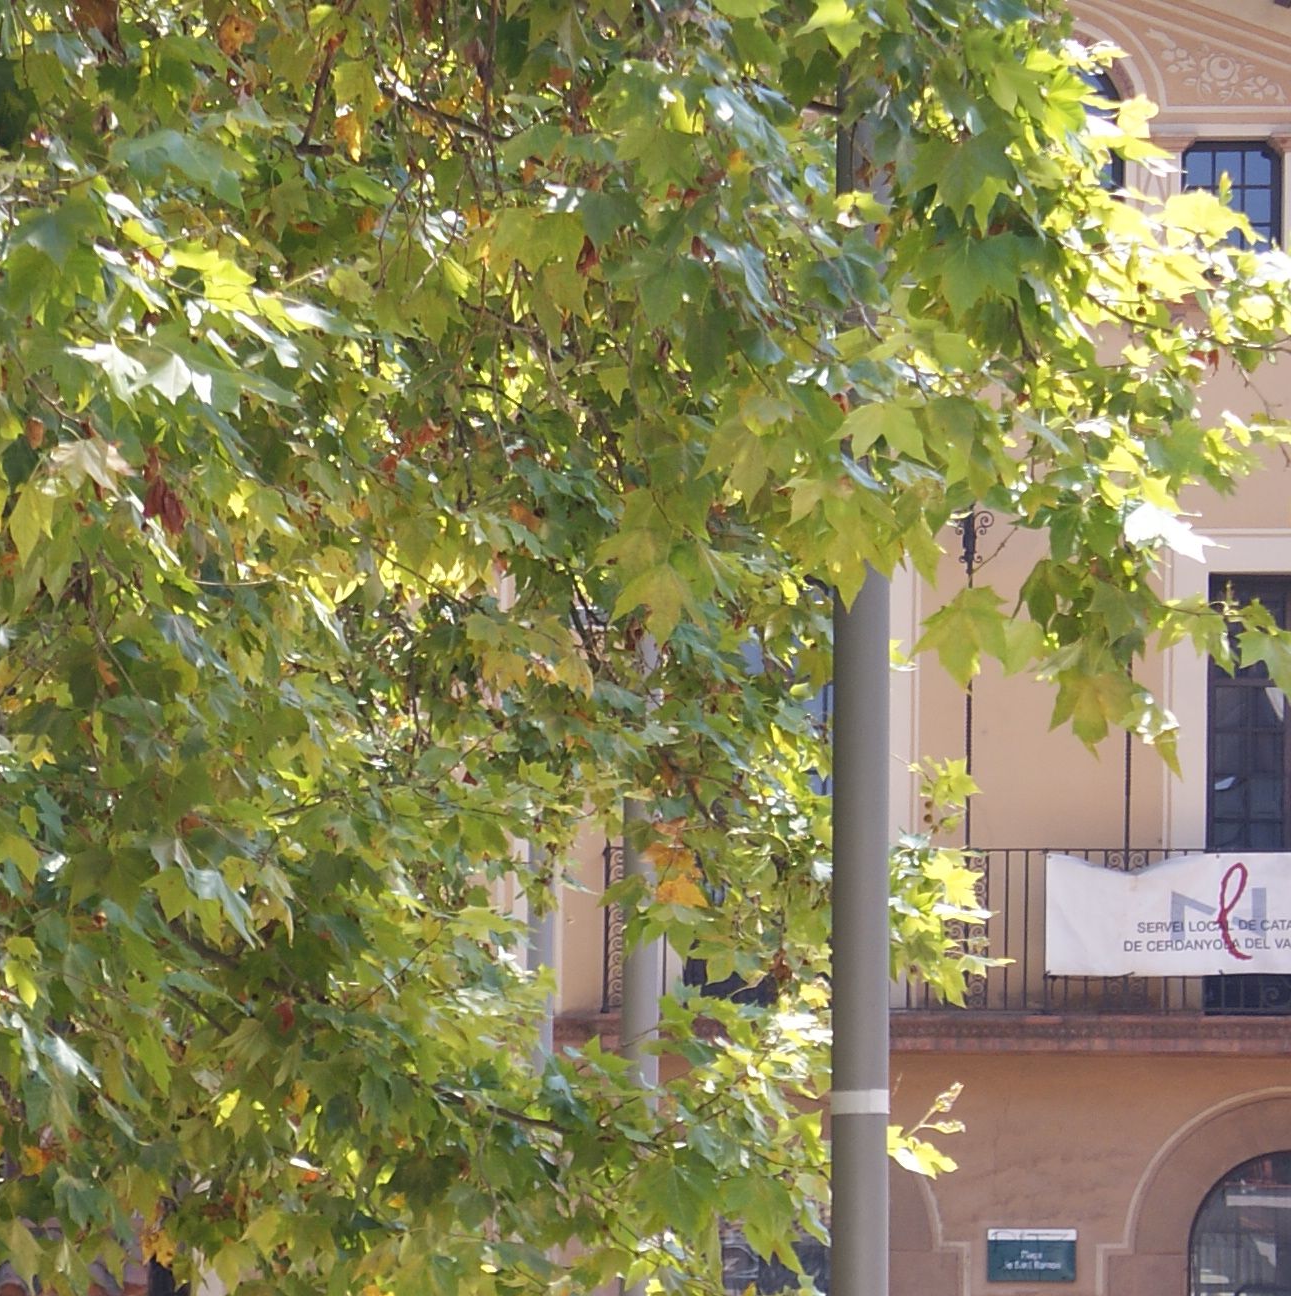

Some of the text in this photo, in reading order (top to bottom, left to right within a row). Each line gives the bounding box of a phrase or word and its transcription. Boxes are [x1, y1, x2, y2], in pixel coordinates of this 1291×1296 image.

[1137, 920, 1184, 933] SERVEI
[1238, 919, 1257, 931] DE
[1123, 940, 1142, 952] DE
[1244, 937, 1271, 949] DEL
